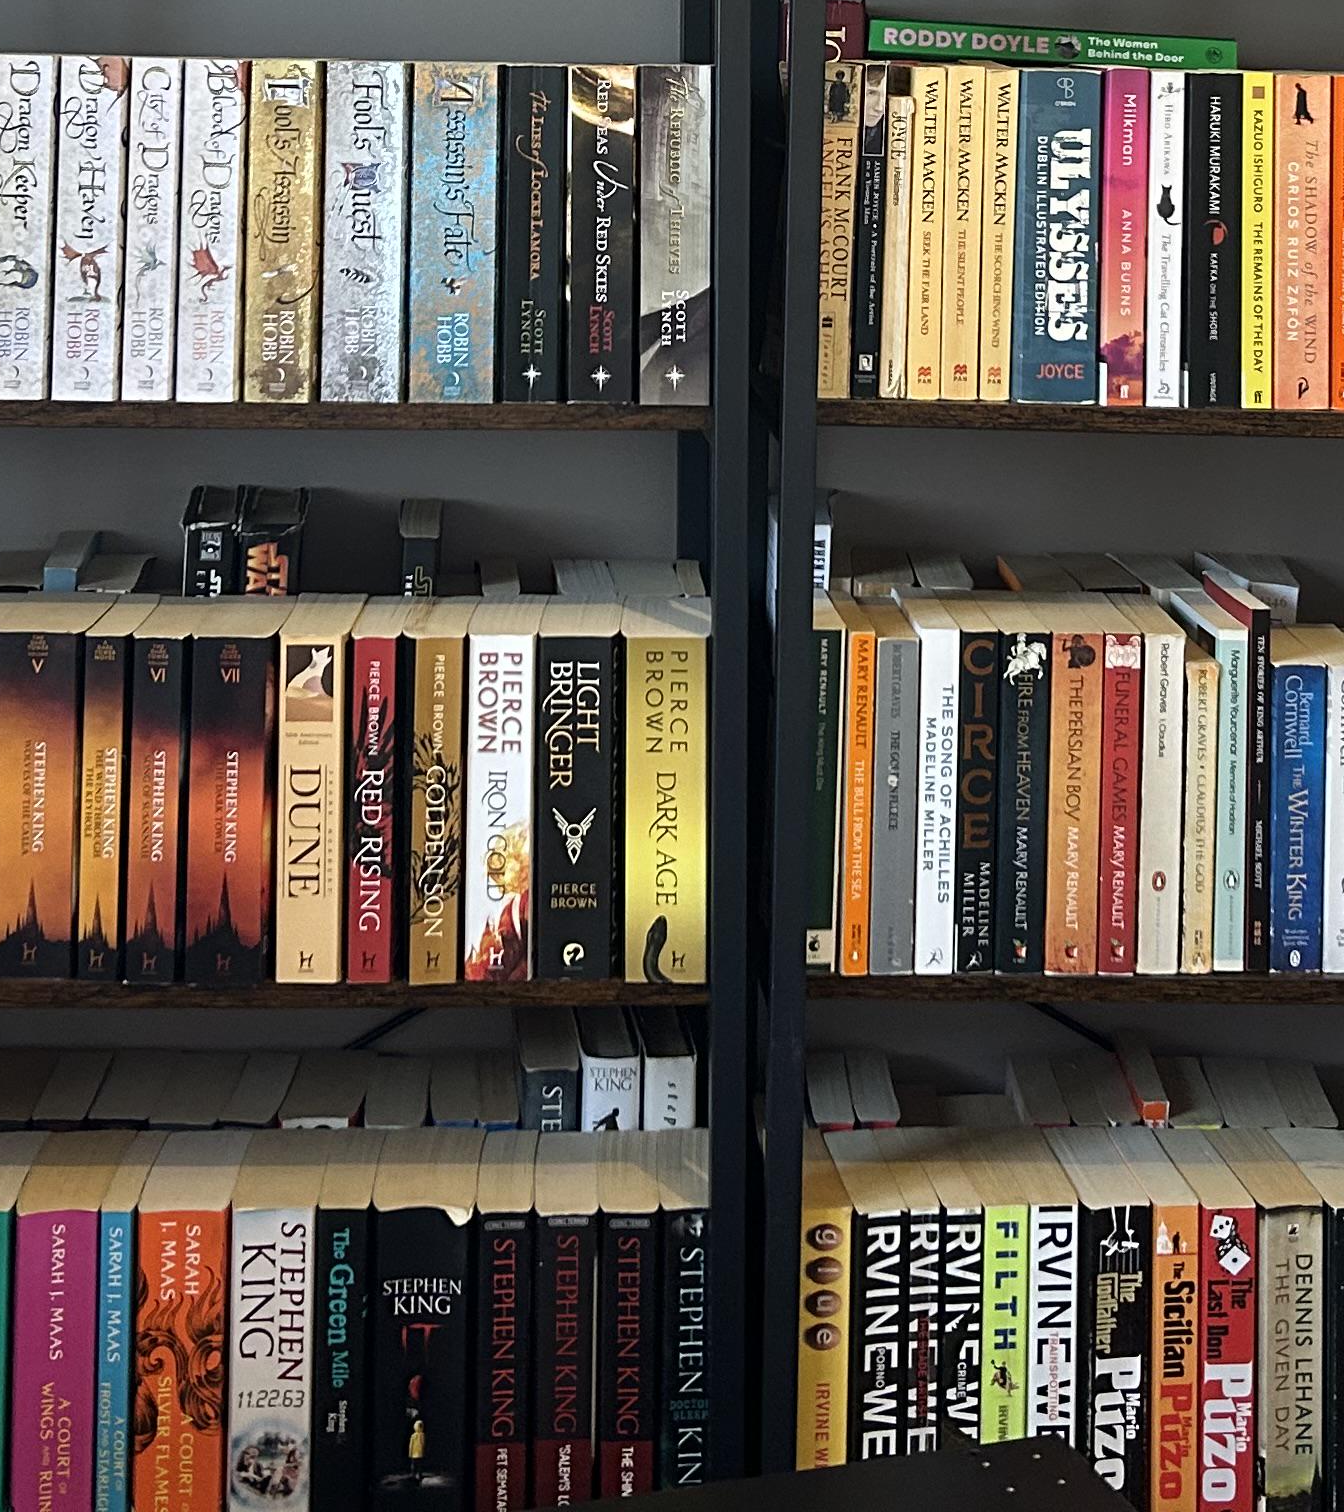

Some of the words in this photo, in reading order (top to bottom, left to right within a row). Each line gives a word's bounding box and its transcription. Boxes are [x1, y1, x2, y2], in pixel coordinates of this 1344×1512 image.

[884, 28, 965, 48] RODDY
[971, 31, 1049, 54] DOYLE
[1088, 37, 1109, 48] The
[1112, 39, 1158, 49] Women
[1088, 49, 1130, 61] Behind
[1132, 51, 1151, 61] the
[1155, 52, 1184, 64] Door
[598, 79, 612, 114] RED
[1209, 96, 1221, 139] HARUKI
[1123, 93, 1137, 166] Milkman
[1208, 144, 1220, 216] MURAKAMI
[596, 217, 612, 252] RED
[1048, 128, 1091, 342] ULYSSES
[1120, 209, 1131, 253] ANNA
[595, 254, 611, 303] SKIES
[1120, 257, 1131, 317] BURNS
[1036, 364, 1084, 380] JOYCE
[548, 662, 573, 789] BRINGER
[577, 662, 599, 752] LIGHT
[962, 639, 995, 849] CIRCE
[360, 769, 384, 827] RED
[289, 768, 321, 898] DUNE
[359, 836, 382, 932] RISING
[963, 873, 975, 937] MILLER
[979, 862, 989, 947] MADELINE
[332, 1228, 349, 1258] The
[239, 1244, 276, 1360] KING
[277, 1221, 307, 1382] STEPHEN
[328, 1264, 353, 1345] Green
[383, 1279, 462, 1296] STEPHEN
[393, 1296, 451, 1316] KING
[994, 1221, 1019, 1351] FILTH
[401, 1325, 442, 1351] IT
[332, 1351, 348, 1387] Mile
[236, 1390, 304, 1408] 11.22.63
